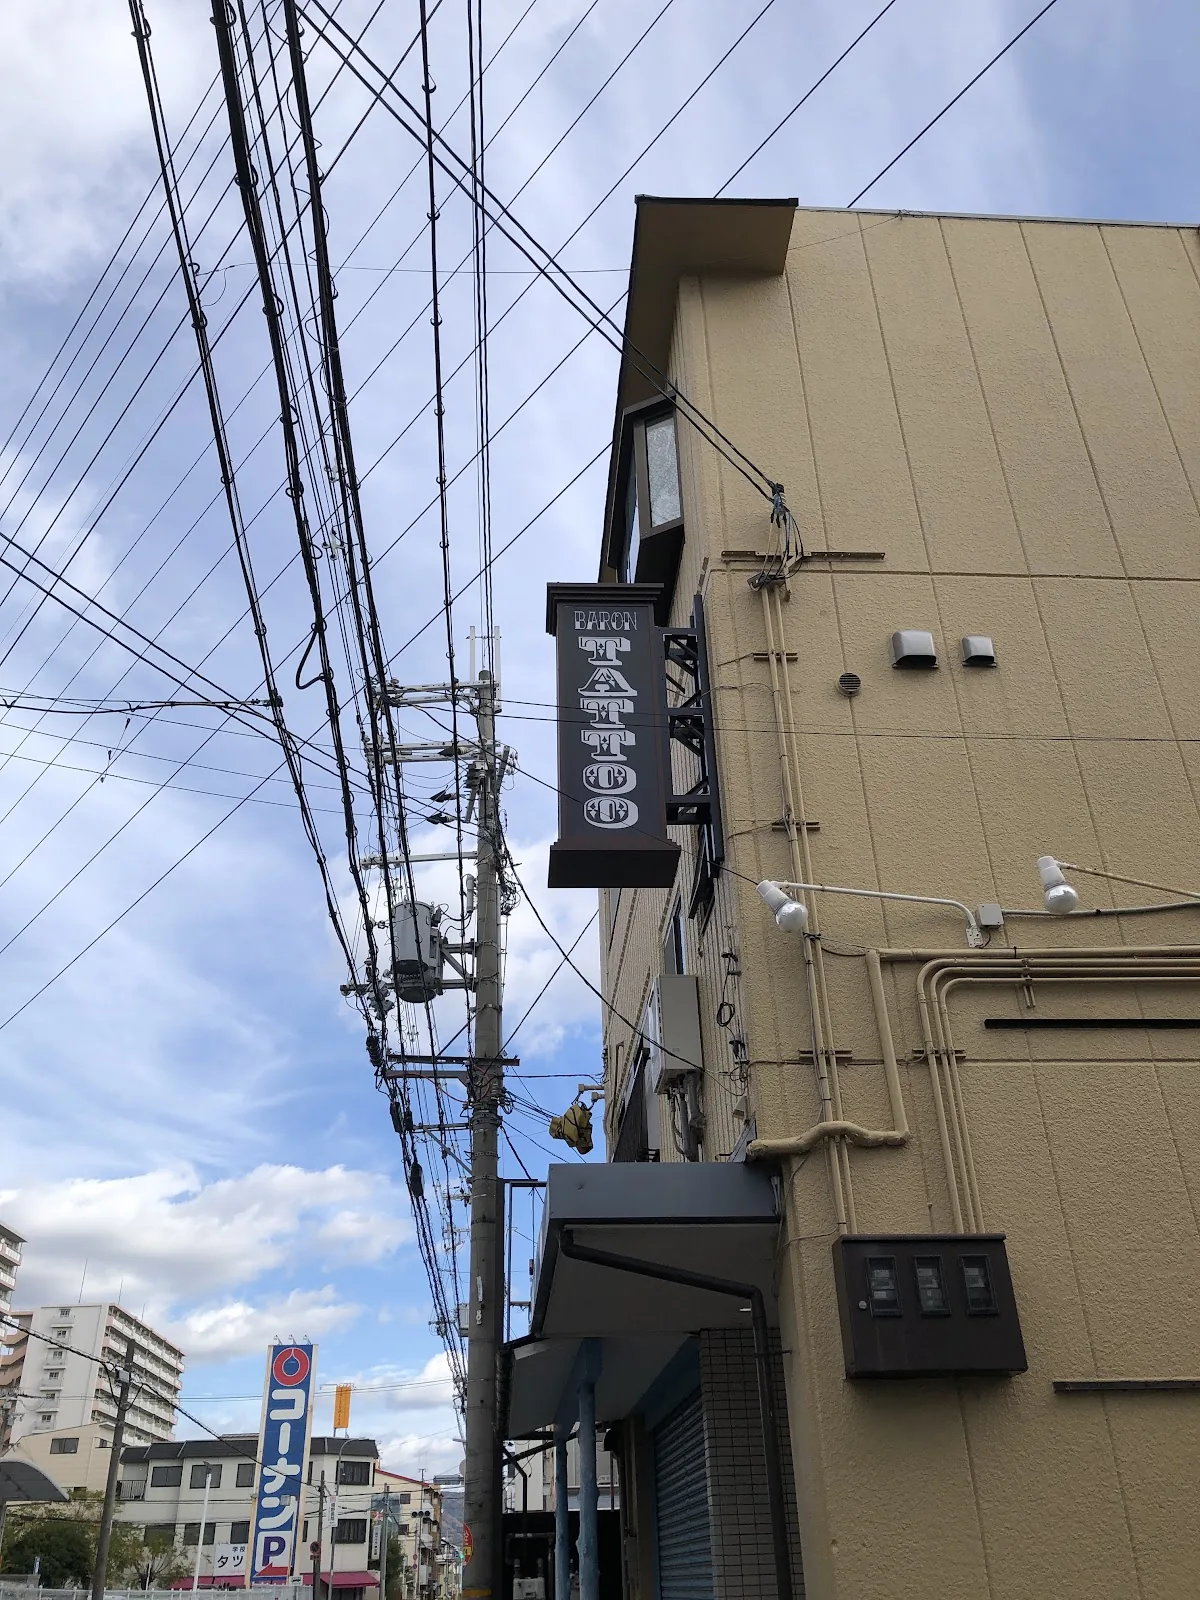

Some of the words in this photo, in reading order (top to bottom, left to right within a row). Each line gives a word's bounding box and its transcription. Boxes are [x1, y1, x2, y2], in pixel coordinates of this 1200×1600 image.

[574, 611, 637, 631] BARON
[578, 636, 639, 829] TATTOO
[259, 1389, 306, 1529] コーナン
[262, 1536, 286, 1567] P
